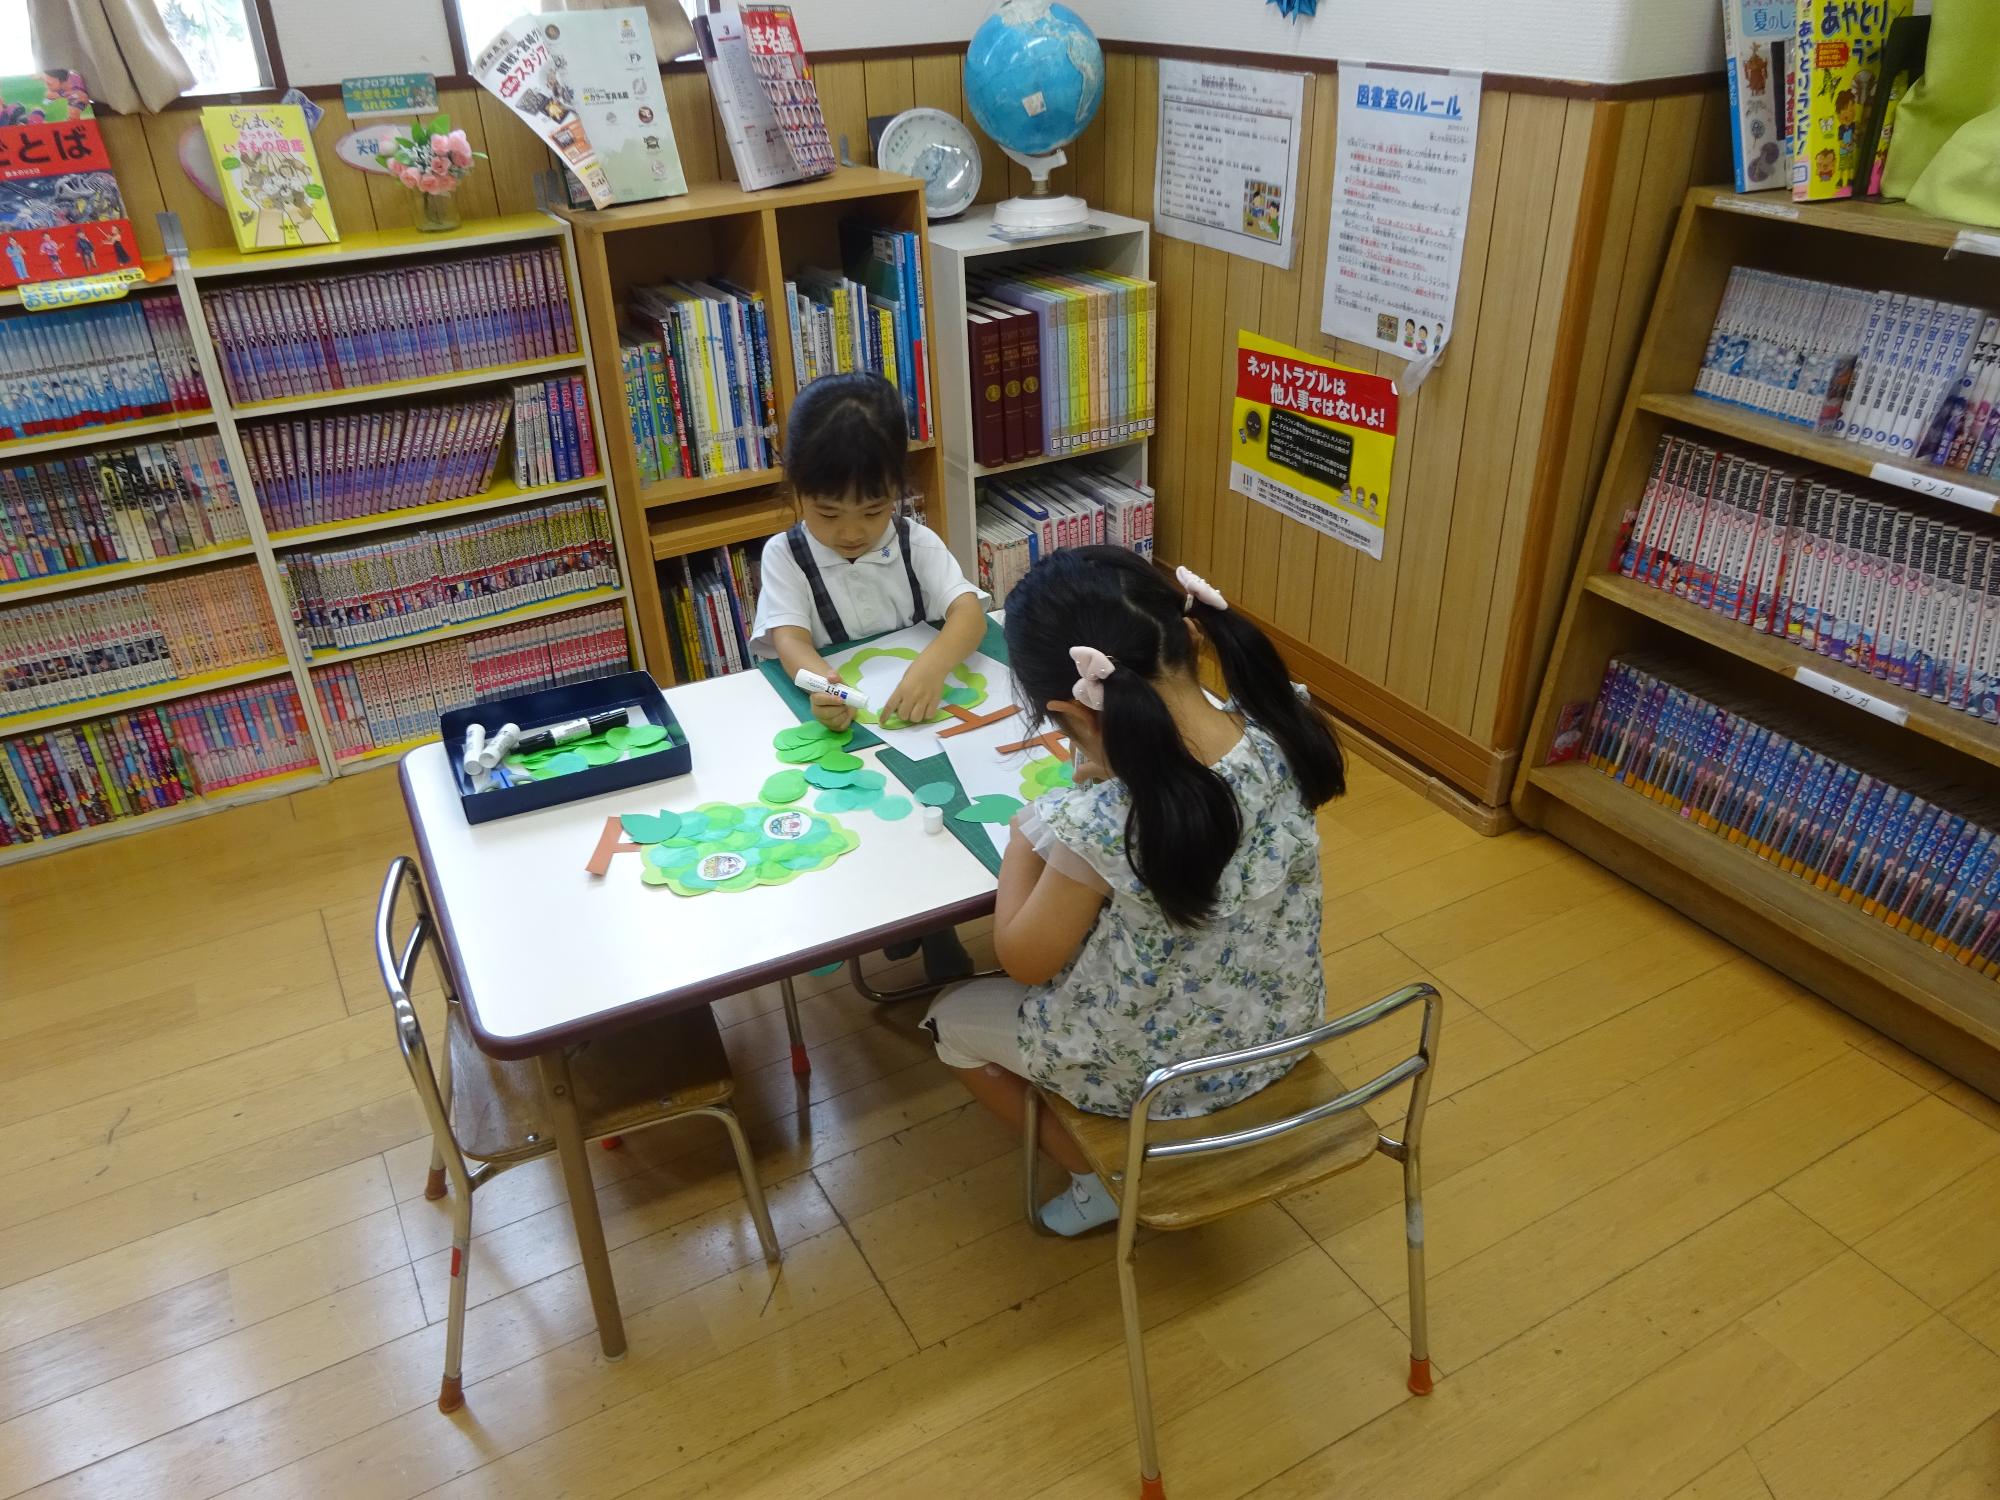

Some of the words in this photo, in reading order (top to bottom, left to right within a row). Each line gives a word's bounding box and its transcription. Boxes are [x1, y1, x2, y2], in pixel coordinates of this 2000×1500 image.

[1821, 1, 1888, 38] あやとり
[1357, 85, 1461, 117] 図書室のルール
[223, 139, 305, 153] いきもの図鑑
[1860, 299, 1884, 360] 宇宙兄弟
[1876, 302, 1900, 363] 宇宙兄弟
[1889, 306, 1915, 366] 宇宙兄弟
[1903, 308, 1930, 369] 宇宙兄弟
[1917, 311, 1945, 373] 宇宙兄弟
[1931, 314, 1960, 375] 宇宙兄弟
[1944, 317, 1976, 378] 宇宙兄弟
[1973, 342, 1987, 363] マギ
[1247, 355, 1346, 396] ネットトラブルは
[1270, 382, 1385, 429] 他人事ではないよ!
[1911, 477, 1954, 498] マンガ
[1831, 684, 1869, 708] マンガ
